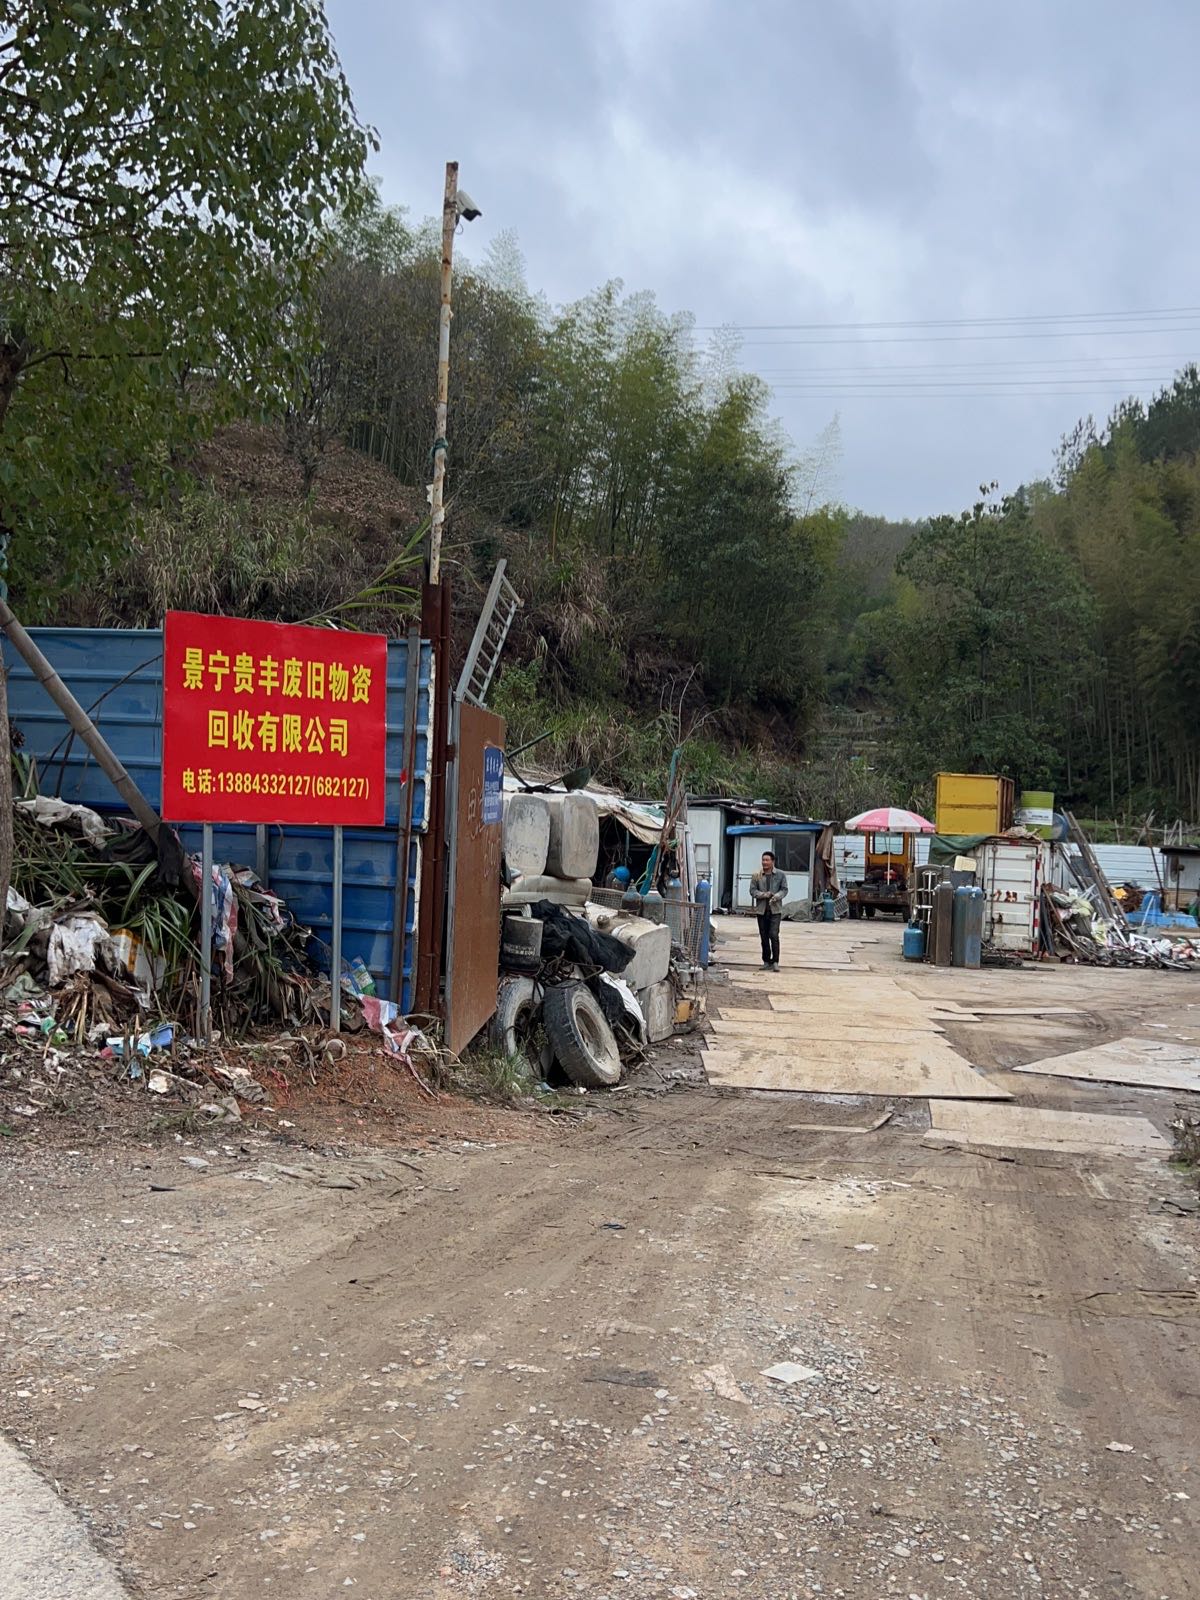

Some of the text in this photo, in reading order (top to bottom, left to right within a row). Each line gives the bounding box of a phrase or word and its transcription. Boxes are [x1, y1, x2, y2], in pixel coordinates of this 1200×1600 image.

[182, 647, 372, 704] 景宁贵丰废旧物资
[208, 709, 349, 757] 回收有限公司
[182, 768, 370, 800] 电话:13884332127(682127)
